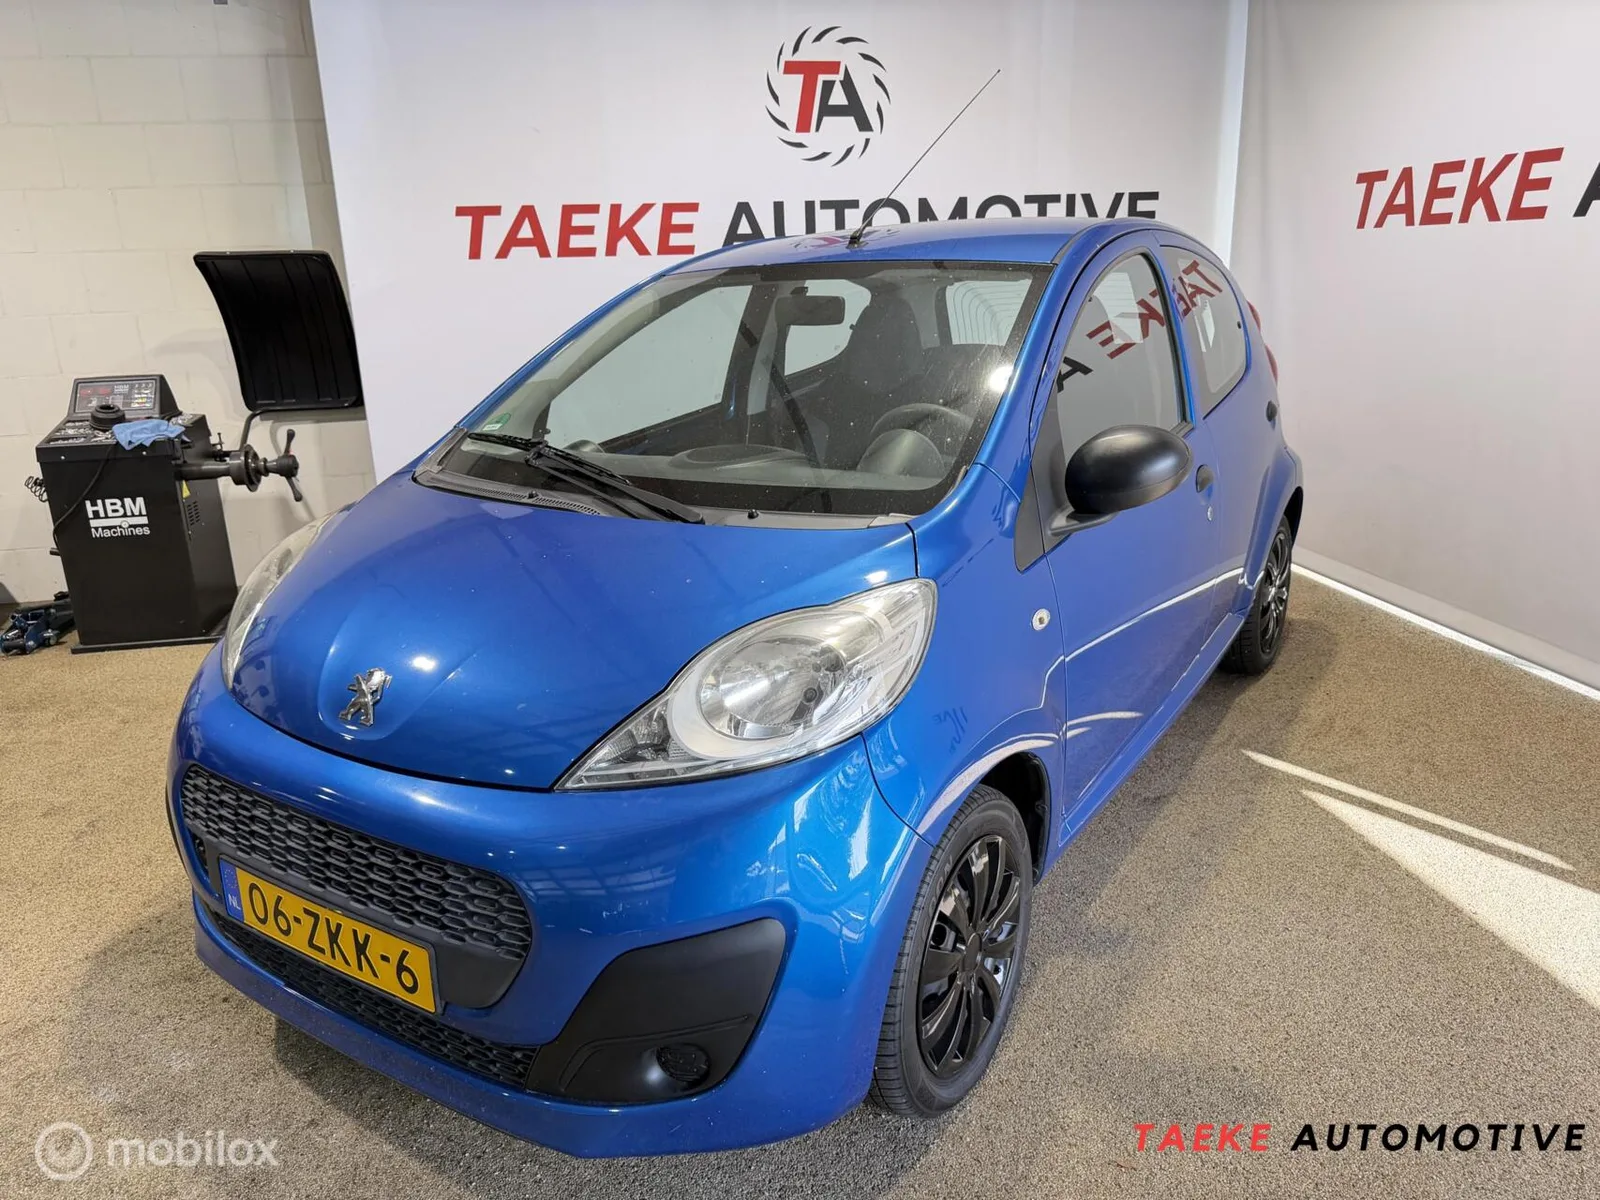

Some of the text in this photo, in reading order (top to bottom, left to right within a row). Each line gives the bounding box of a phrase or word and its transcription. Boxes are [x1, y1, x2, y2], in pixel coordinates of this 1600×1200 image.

[783, 60, 874, 133] TA
[1355, 147, 1564, 229] TAEKE
[455, 202, 700, 260] TAEKE
[85, 497, 147, 518] HBM
[91, 525, 151, 538] Machines
[228, 893, 241, 910] NL
[248, 882, 419, 995] 06-ZKK-6
